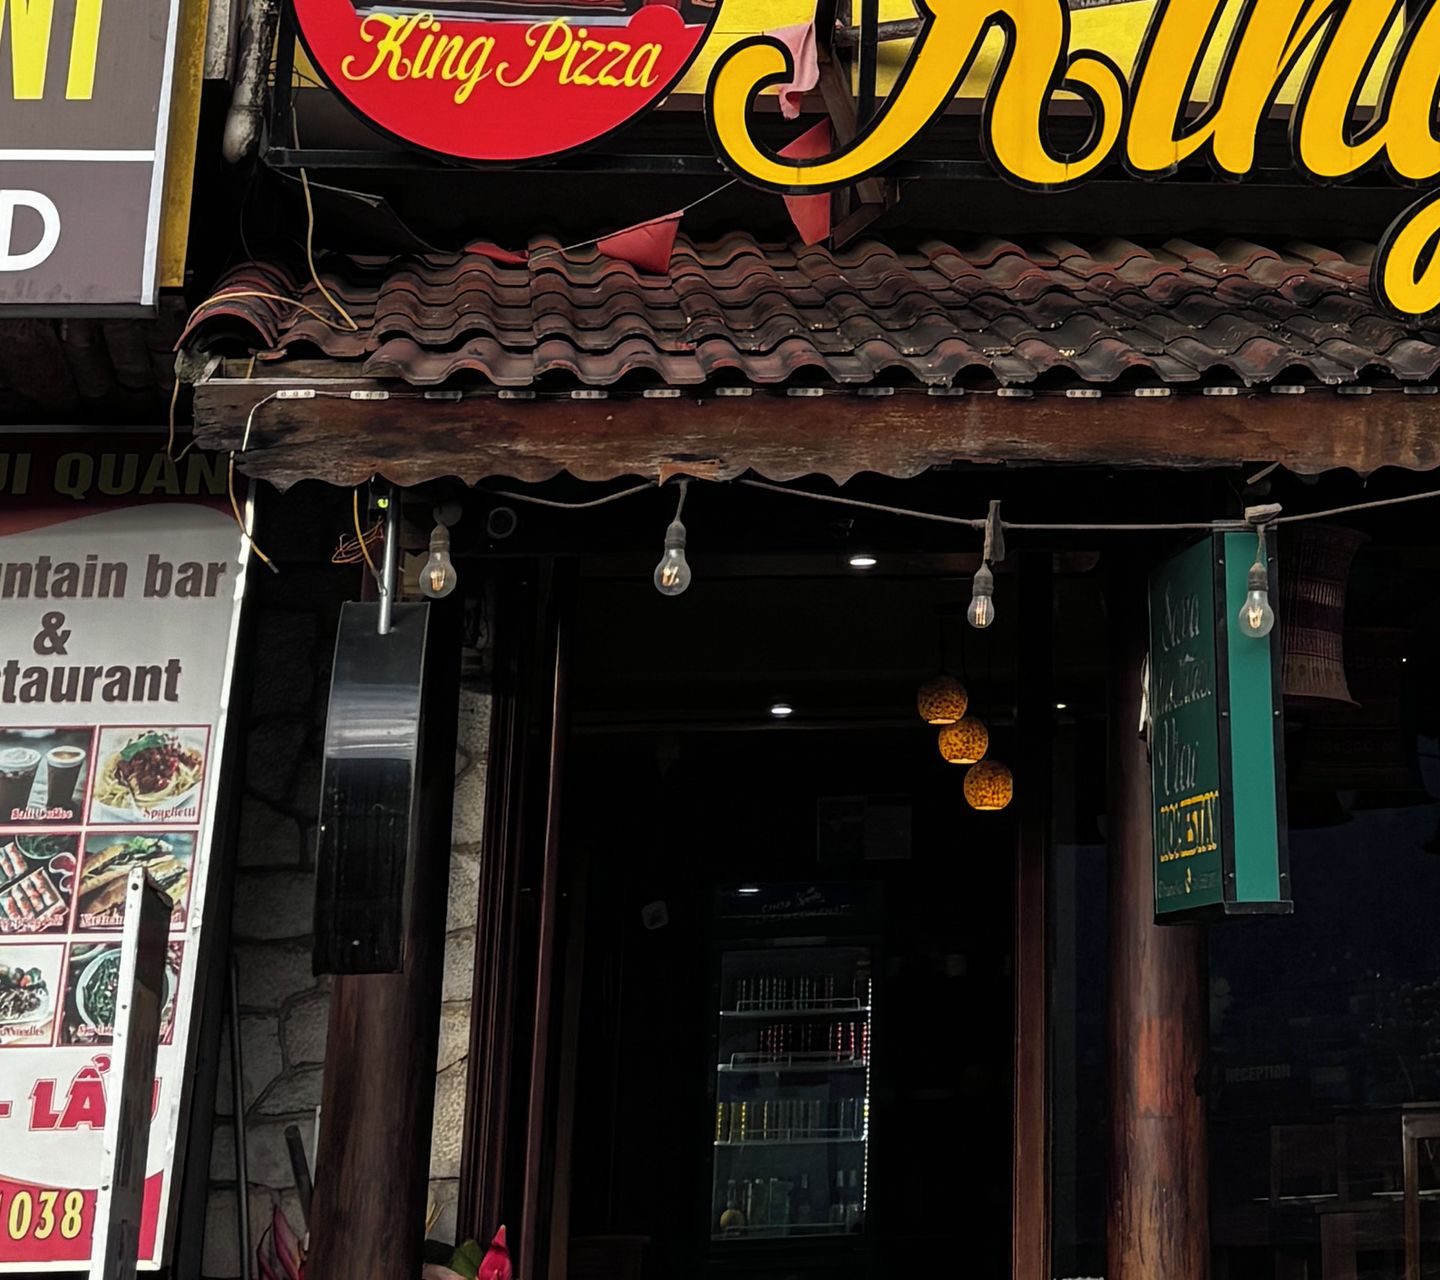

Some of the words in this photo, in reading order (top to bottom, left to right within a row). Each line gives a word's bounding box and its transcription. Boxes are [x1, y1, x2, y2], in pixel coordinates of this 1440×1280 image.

[341, 11, 496, 104] King
[496, 16, 663, 88] Pizza
[0, 554, 128, 599] ntain
[143, 554, 227, 598] bar
[33, 611, 72, 655] &
[0, 658, 182, 704] taurant
[143, 806, 196, 819] Spaghetti
[28, 1053, 162, 1132] LẨ
[0, 1189, 85, 1241] 038
